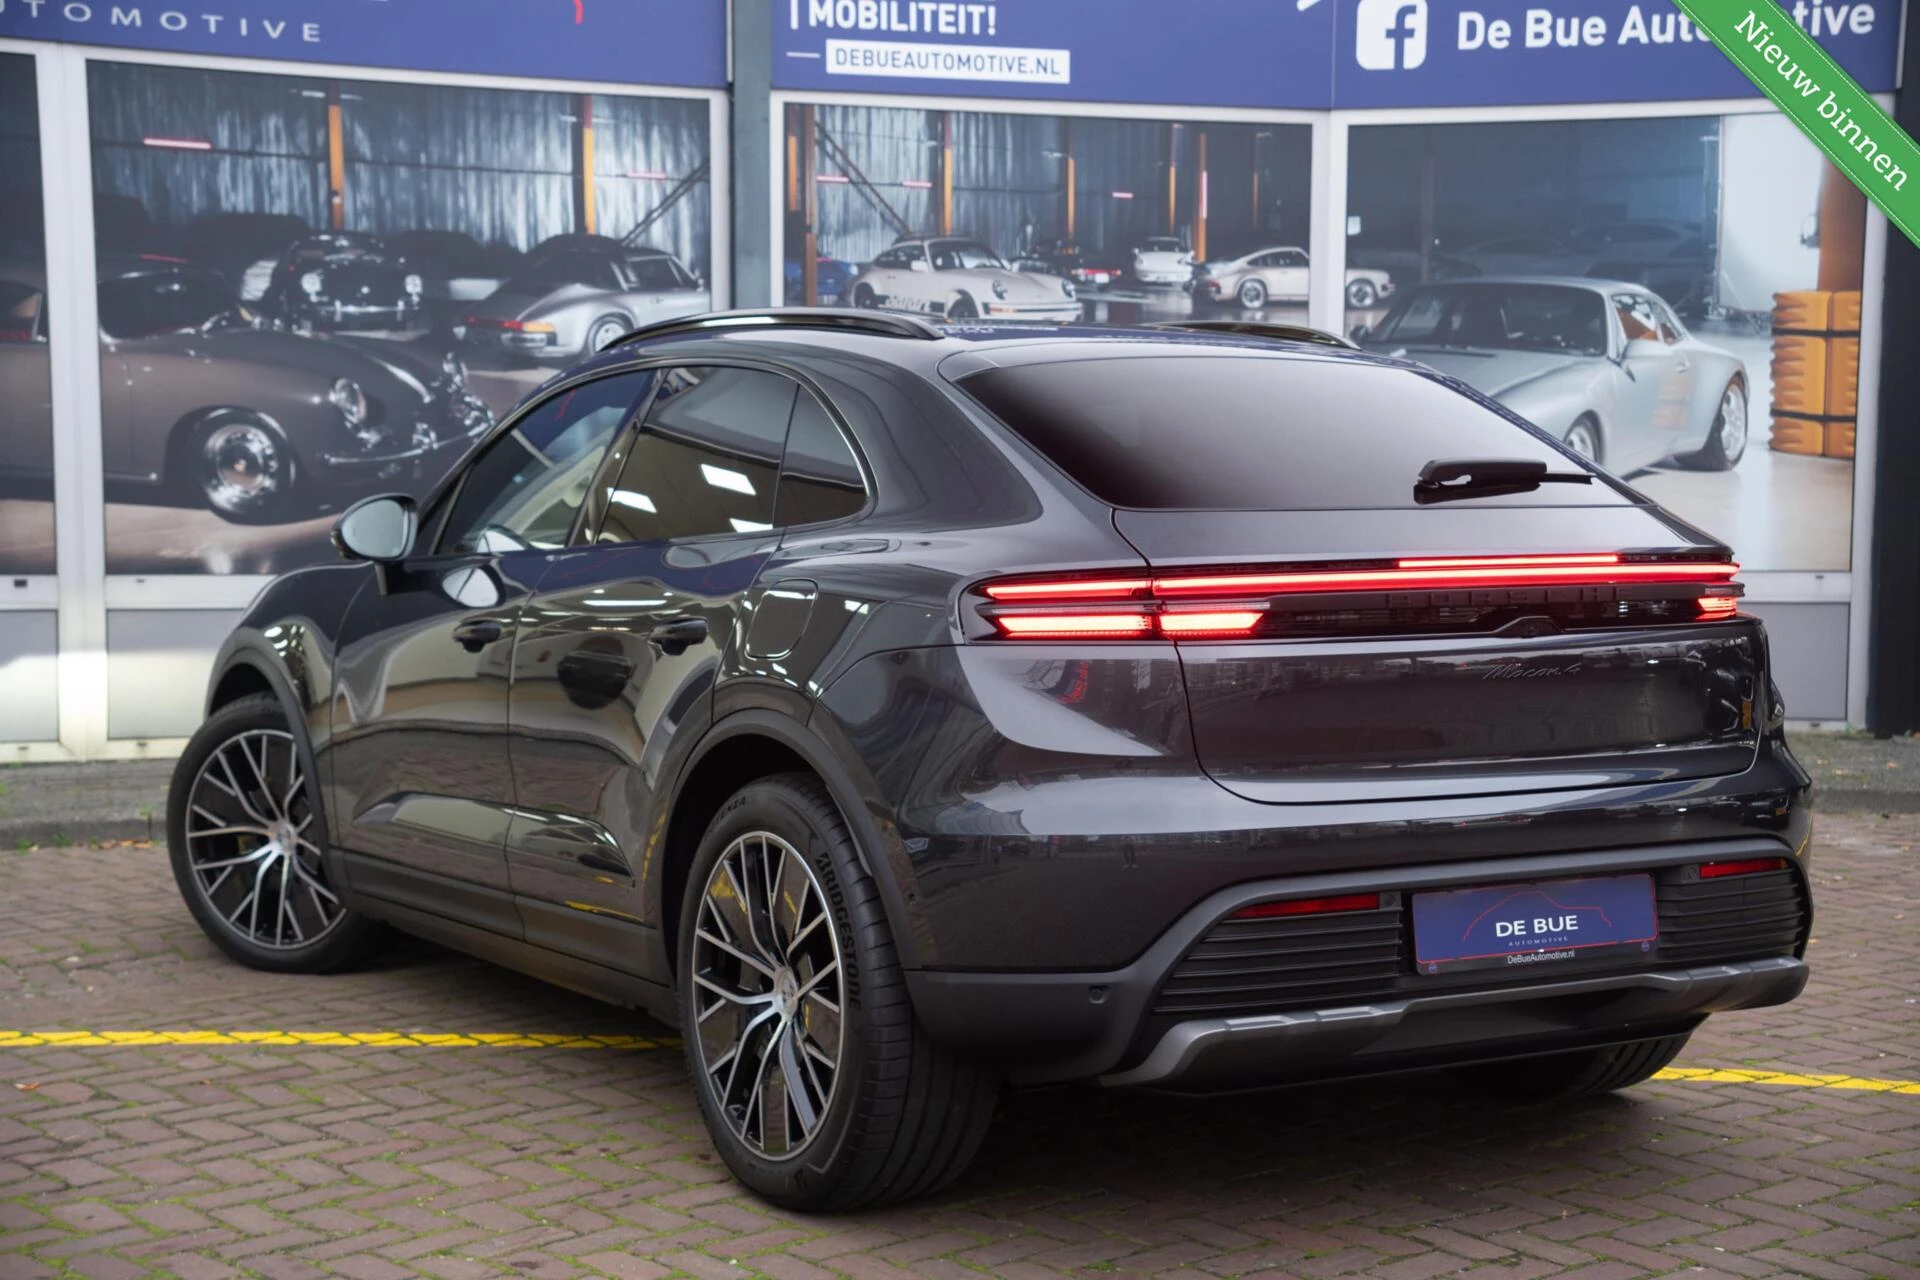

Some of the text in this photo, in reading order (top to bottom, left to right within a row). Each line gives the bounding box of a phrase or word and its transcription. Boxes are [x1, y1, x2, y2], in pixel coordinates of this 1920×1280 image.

[0, 0, 321, 43] TOMOTIVE
[808, 0, 997, 36] MOBILITEIT!
[1458, 11, 1512, 50] De
[1525, 9, 1606, 48] Bue
[834, 47, 1061, 76] DEBUEAUTOMOTIVE.NL
[815, 851, 863, 1014] BRIDGESTONE
[1495, 914, 1579, 938] DE BUE
[1508, 935, 1568, 947] AUTOMOTIVE
[1507, 948, 1576, 965] DeBueAutomotive.nl
